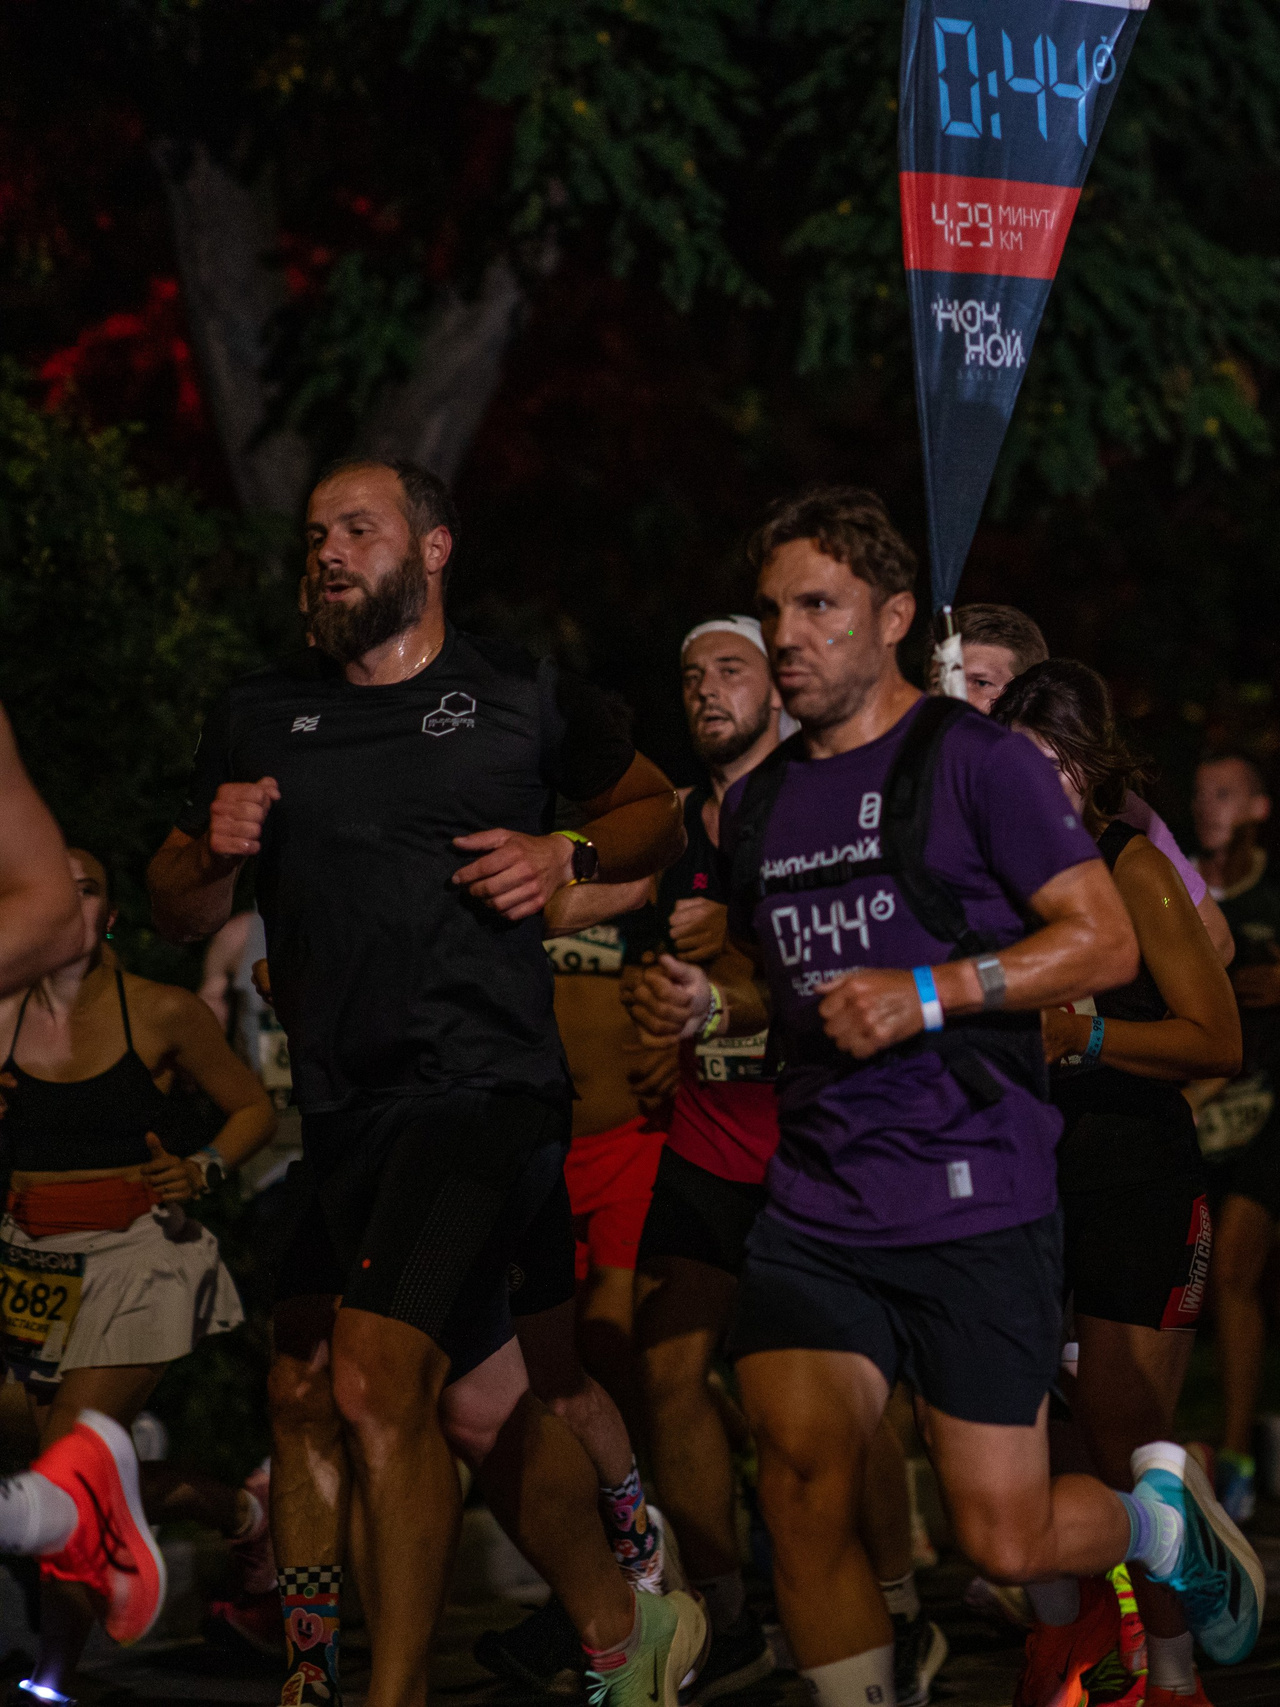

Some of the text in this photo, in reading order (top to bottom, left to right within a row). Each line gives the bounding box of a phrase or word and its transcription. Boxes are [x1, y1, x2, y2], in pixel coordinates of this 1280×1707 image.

[934, 17, 1087, 146] 0:44
[931, 202, 993, 247] 4:29
[1000, 231, 1023, 251] КМ
[770, 894, 870, 966] 0:44
[1183, 1205, 1212, 1311] World Class
[0, 1276, 68, 1321] 1682
